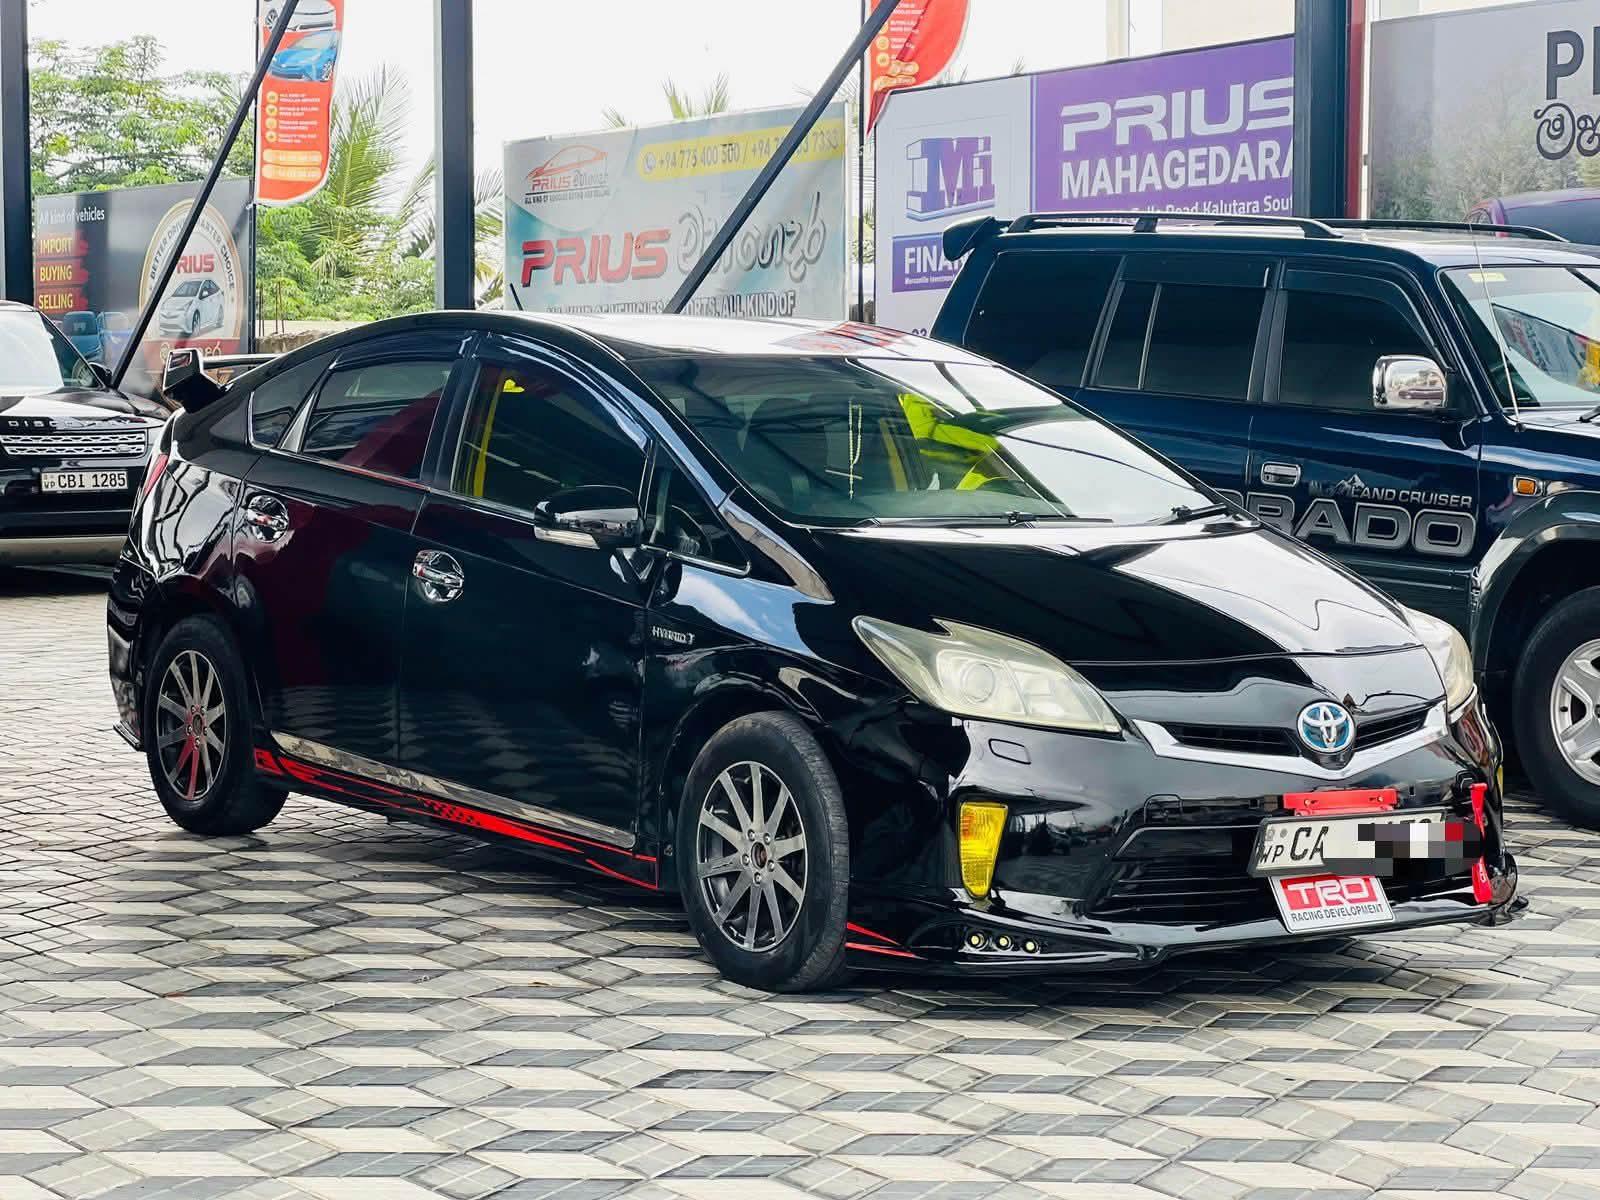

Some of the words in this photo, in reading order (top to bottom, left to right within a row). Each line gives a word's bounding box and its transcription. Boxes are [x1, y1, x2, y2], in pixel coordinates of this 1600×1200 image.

[1060, 77, 1294, 151] PRIUS
[700, 145, 718, 166] 400
[75, 206, 105, 223] vehicles
[1203, 199, 1260, 214] Kalutara
[40, 238, 74, 254] IMPORT
[177, 253, 215, 274] RIUS
[220, 244, 235, 289] CHOICE
[521, 229, 671, 288] PRIUS
[40, 265, 72, 282] BUYING
[38, 293, 73, 309] SELLING
[745, 291, 776, 317] KIND
[779, 289, 796, 316] OF
[58, 474, 85, 488] CBI
[92, 472, 126, 487] 1285
[1352, 487, 1396, 501] LAND
[1399, 490, 1472, 508] CRUISER
[1259, 845, 1284, 863] WP
[1287, 878, 1370, 908] TRD
[1291, 910, 1323, 922] RACING
[1325, 903, 1384, 918] DEVELOPMENT
